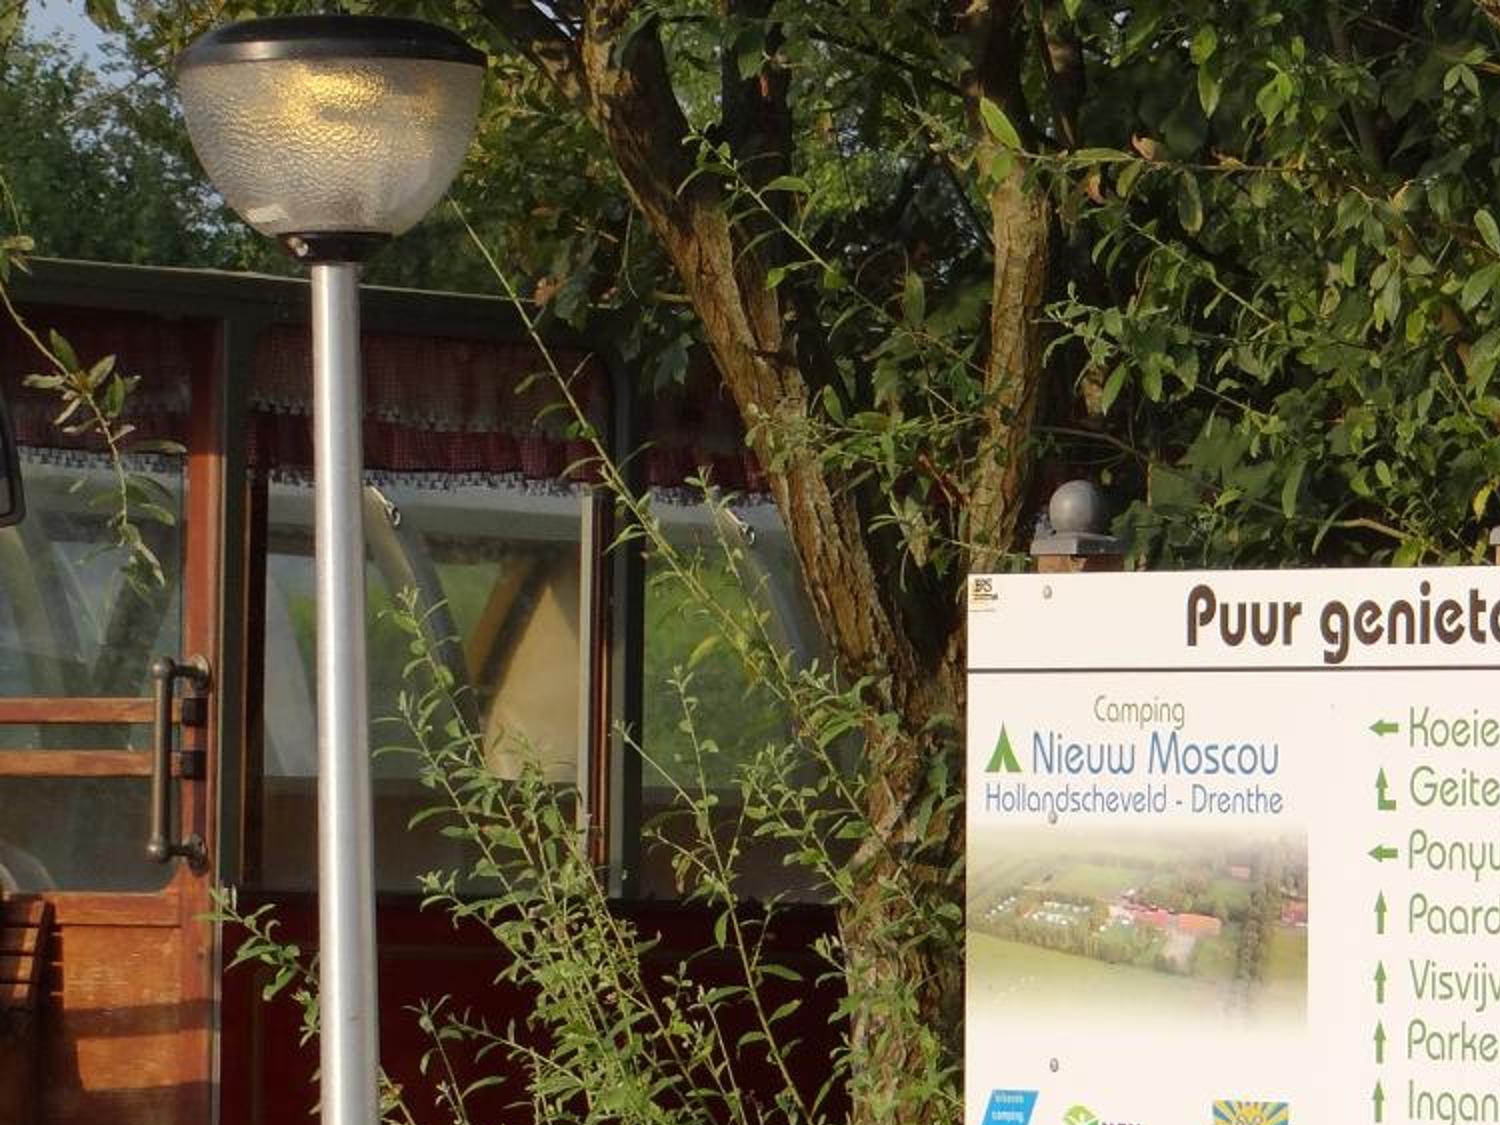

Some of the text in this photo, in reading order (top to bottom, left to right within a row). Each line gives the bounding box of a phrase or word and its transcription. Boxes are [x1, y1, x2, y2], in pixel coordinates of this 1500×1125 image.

[1187, 584, 1302, 646] Puur
[1094, 695, 1184, 730] Camping
[1033, 731, 1278, 775] Nieuw Moscou
[986, 782, 1166, 813] Hollandscheveld
[1192, 784, 1284, 814] Drenthe
